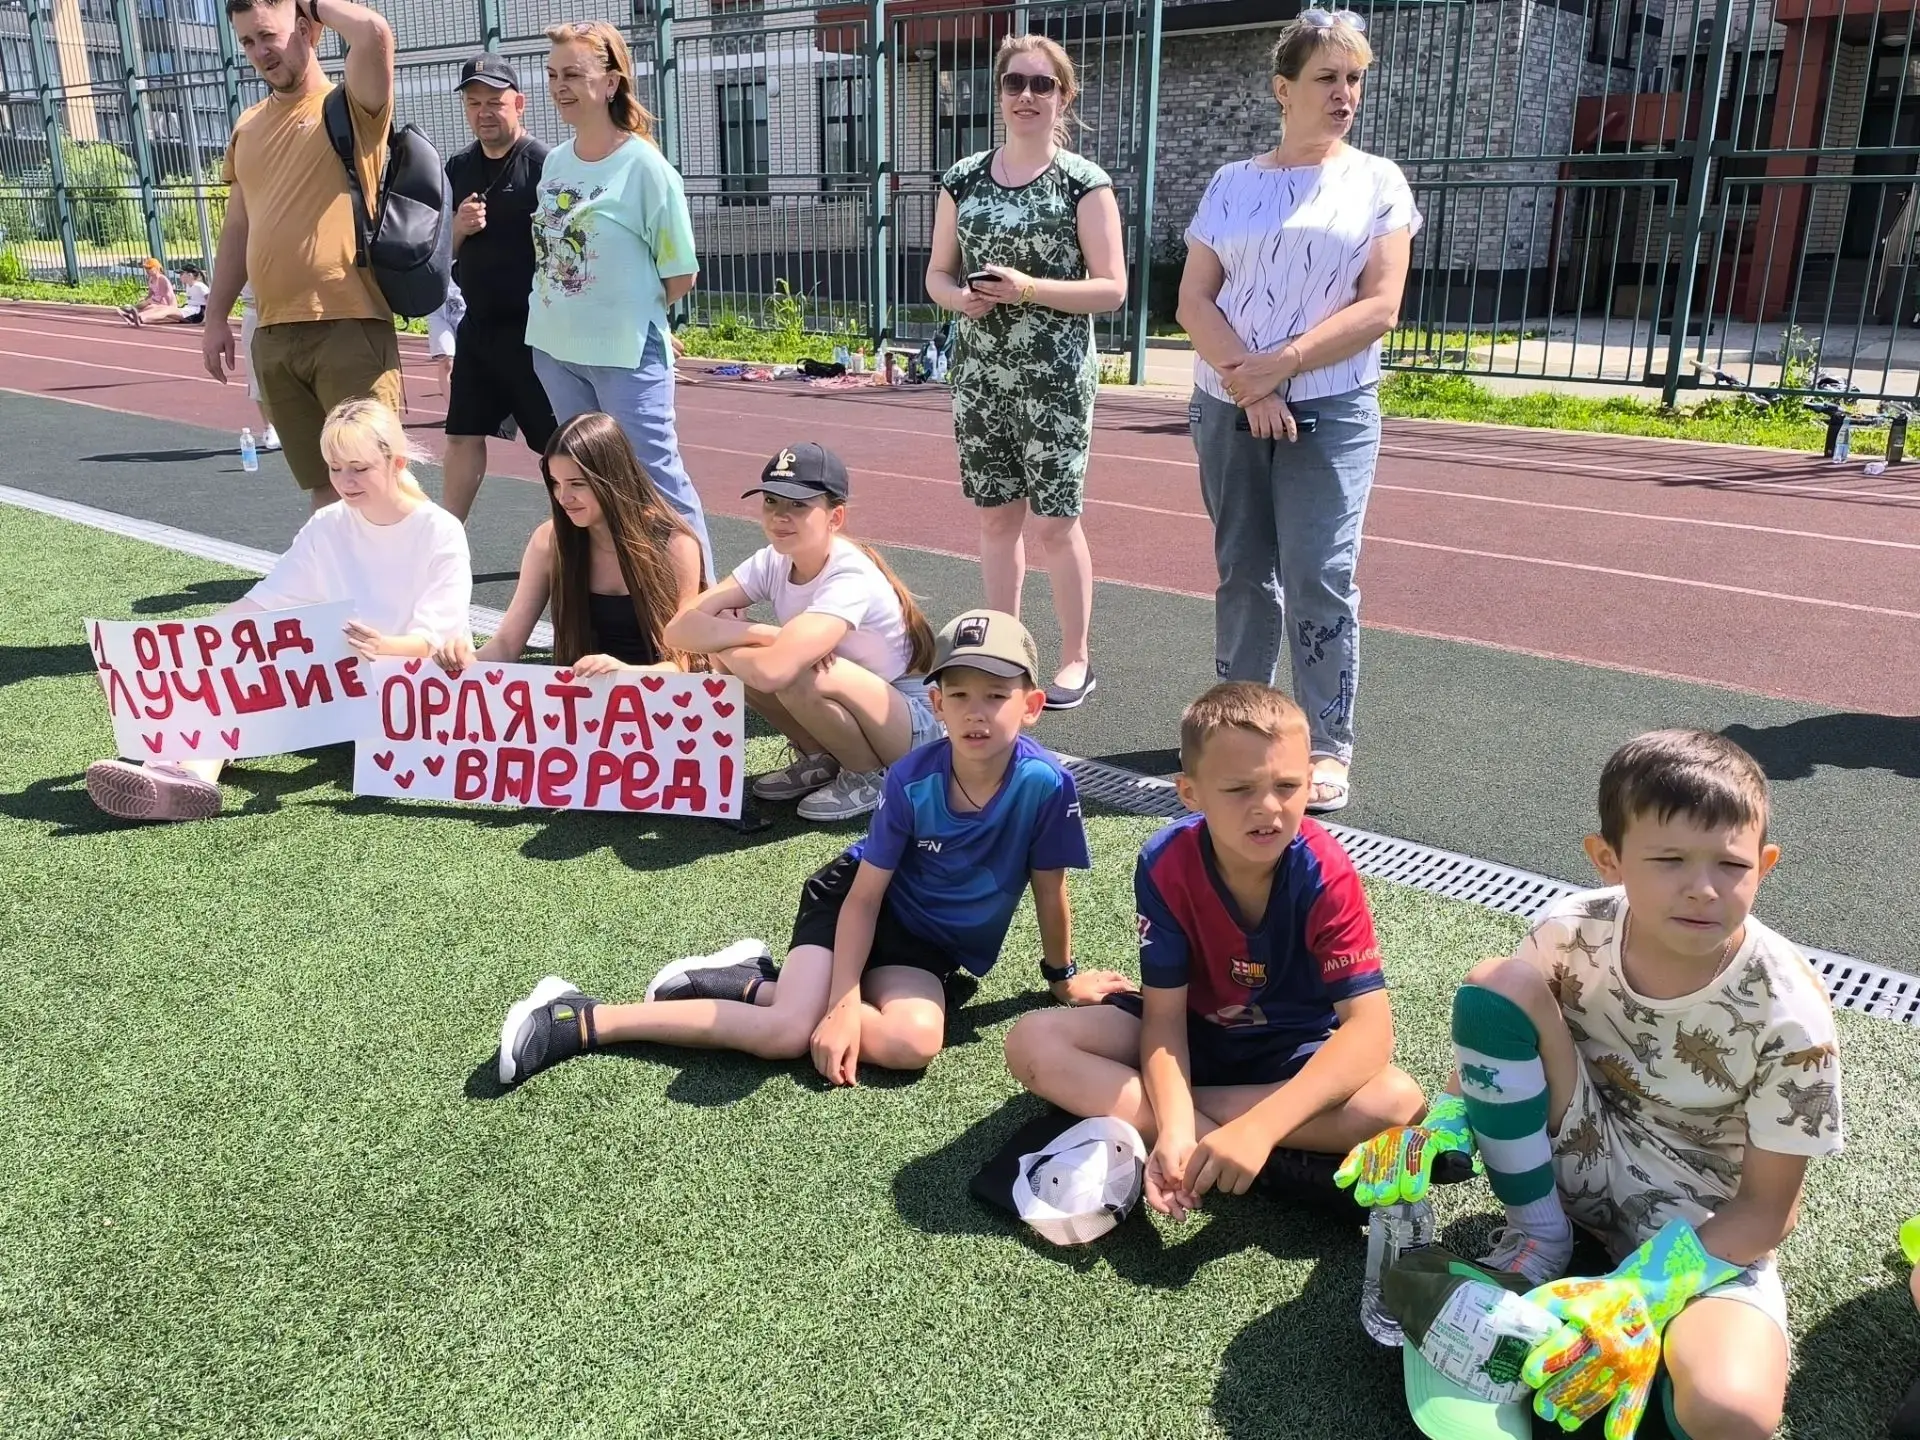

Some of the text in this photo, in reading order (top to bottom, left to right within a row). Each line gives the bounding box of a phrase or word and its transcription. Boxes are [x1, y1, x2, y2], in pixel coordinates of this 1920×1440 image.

[95, 618, 314, 670] 1 ОТРЯД
[110, 656, 367, 720] ЛУЧШИЕ
[382, 674, 655, 750] ОРЛЯТА
